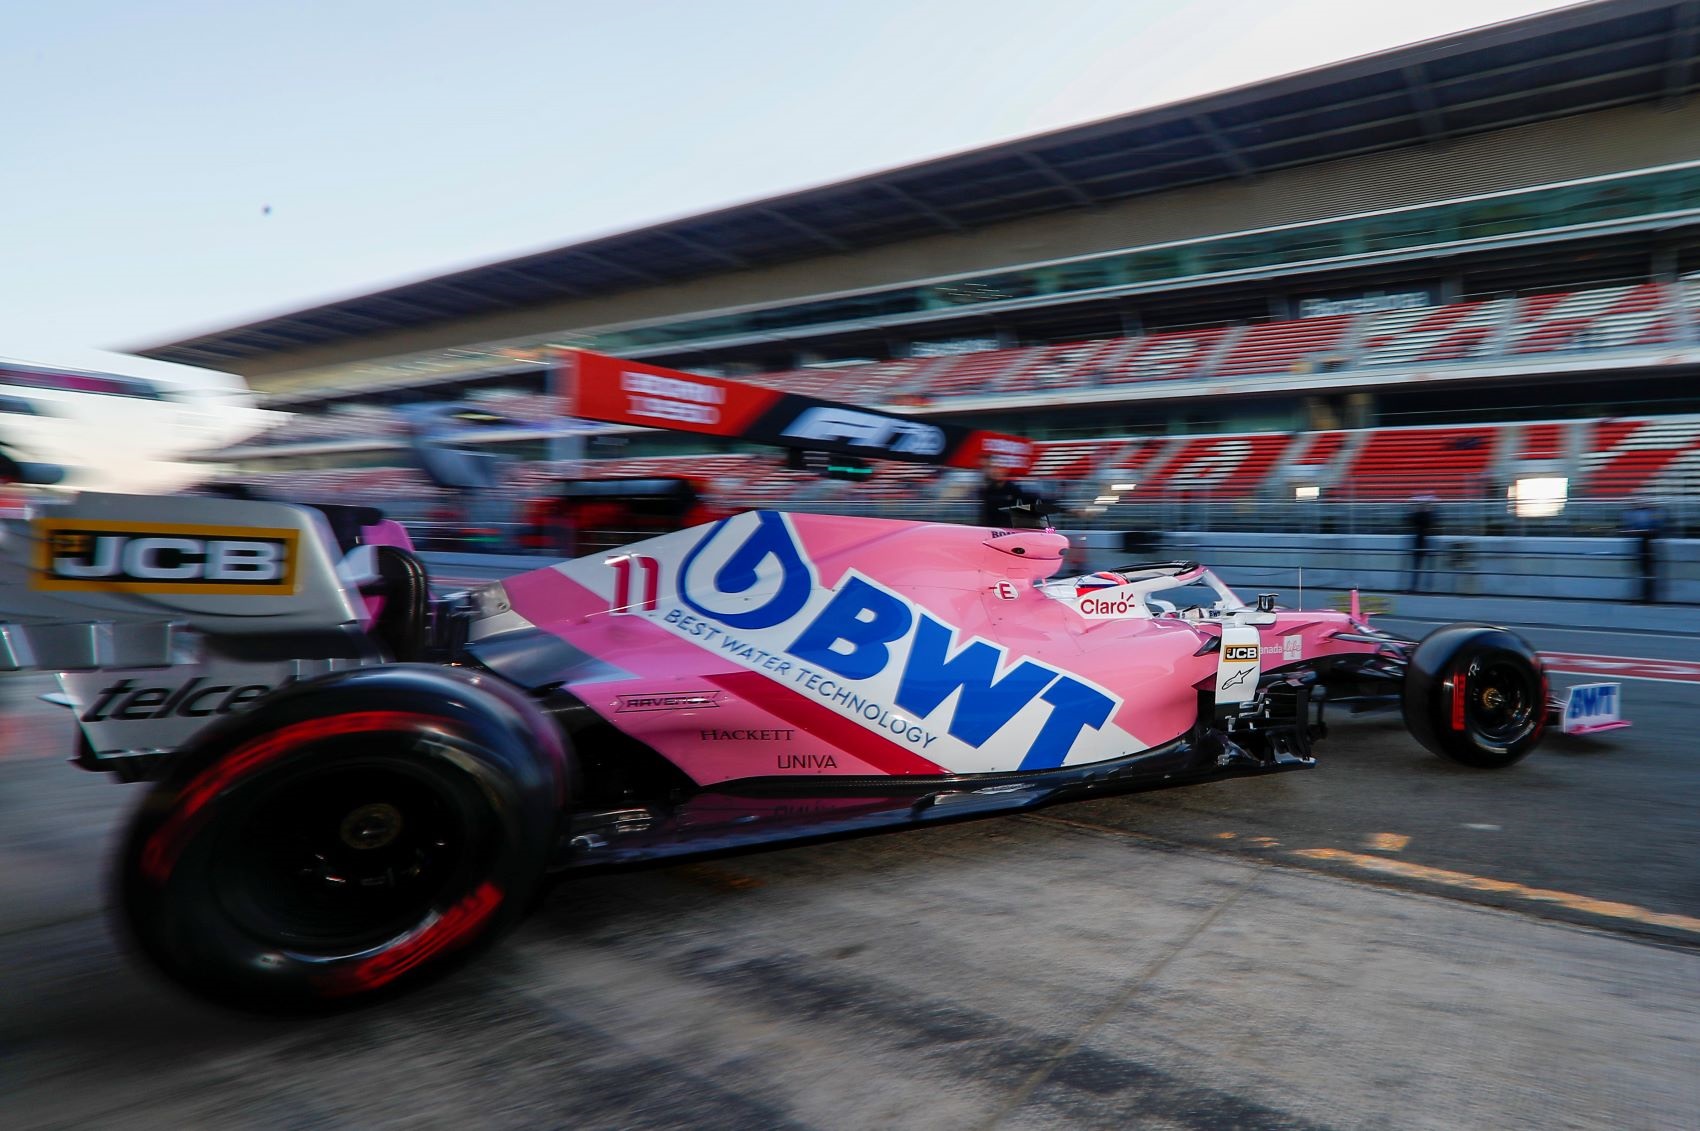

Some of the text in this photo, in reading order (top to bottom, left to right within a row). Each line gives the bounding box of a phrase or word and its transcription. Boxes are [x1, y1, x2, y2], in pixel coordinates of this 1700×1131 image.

[53, 536, 286, 580] JCB
[605, 555, 660, 613] 11
[999, 583, 1015, 600] E
[1080, 597, 1129, 615] Claro
[1226, 648, 1257, 659] JCB
[1260, 643, 1283, 654] anada
[664, 609, 939, 750] BEST WATER TECHNOLOGY
[786, 576, 1115, 771] BWT
[81, 675, 297, 722] telce
[1570, 686, 1617, 719] BWT
[700, 729, 795, 741] HACKETT
[777, 754, 838, 769] UNIVA
